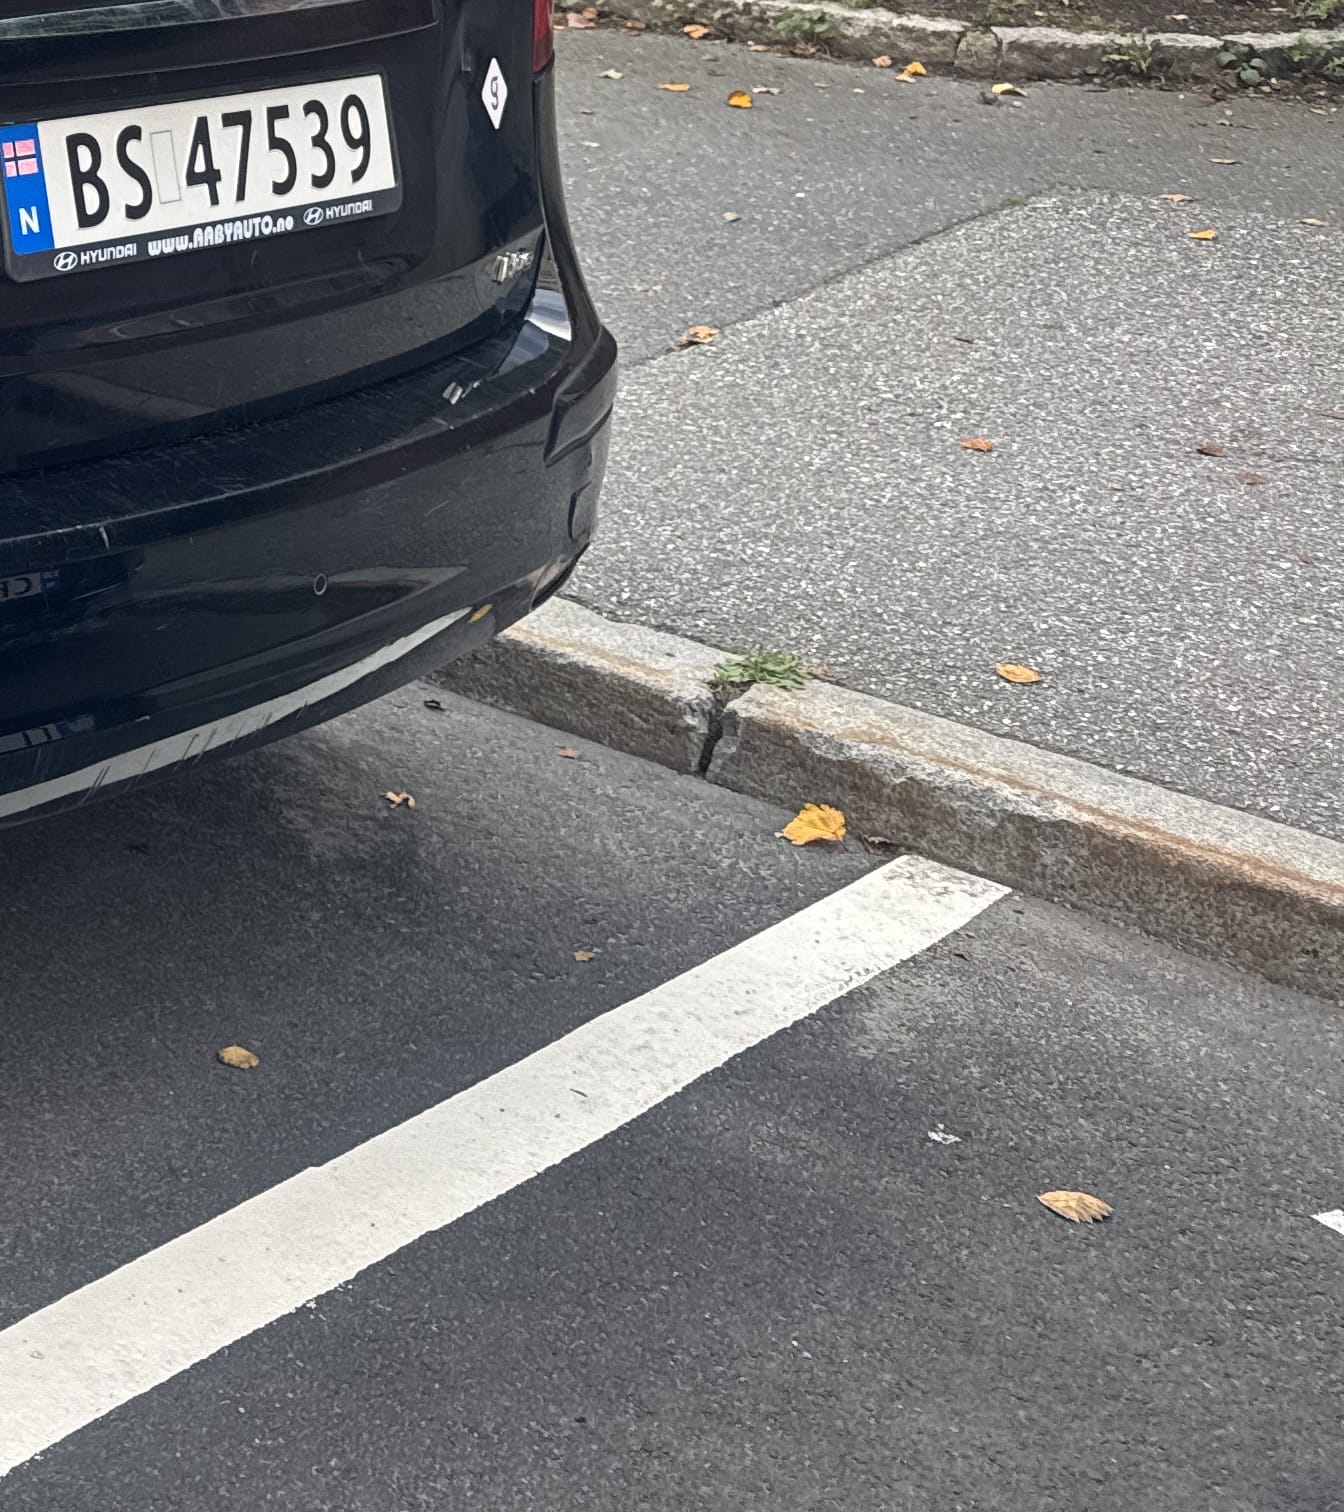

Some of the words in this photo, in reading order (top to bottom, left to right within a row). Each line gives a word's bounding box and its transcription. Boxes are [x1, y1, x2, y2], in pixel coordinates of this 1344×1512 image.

[65, 124, 153, 229] BS
[185, 93, 371, 207] 47539
[18, 205, 40, 235] N
[325, 199, 373, 220] HYUNDAI
[80, 243, 137, 266] HYUNDAI
